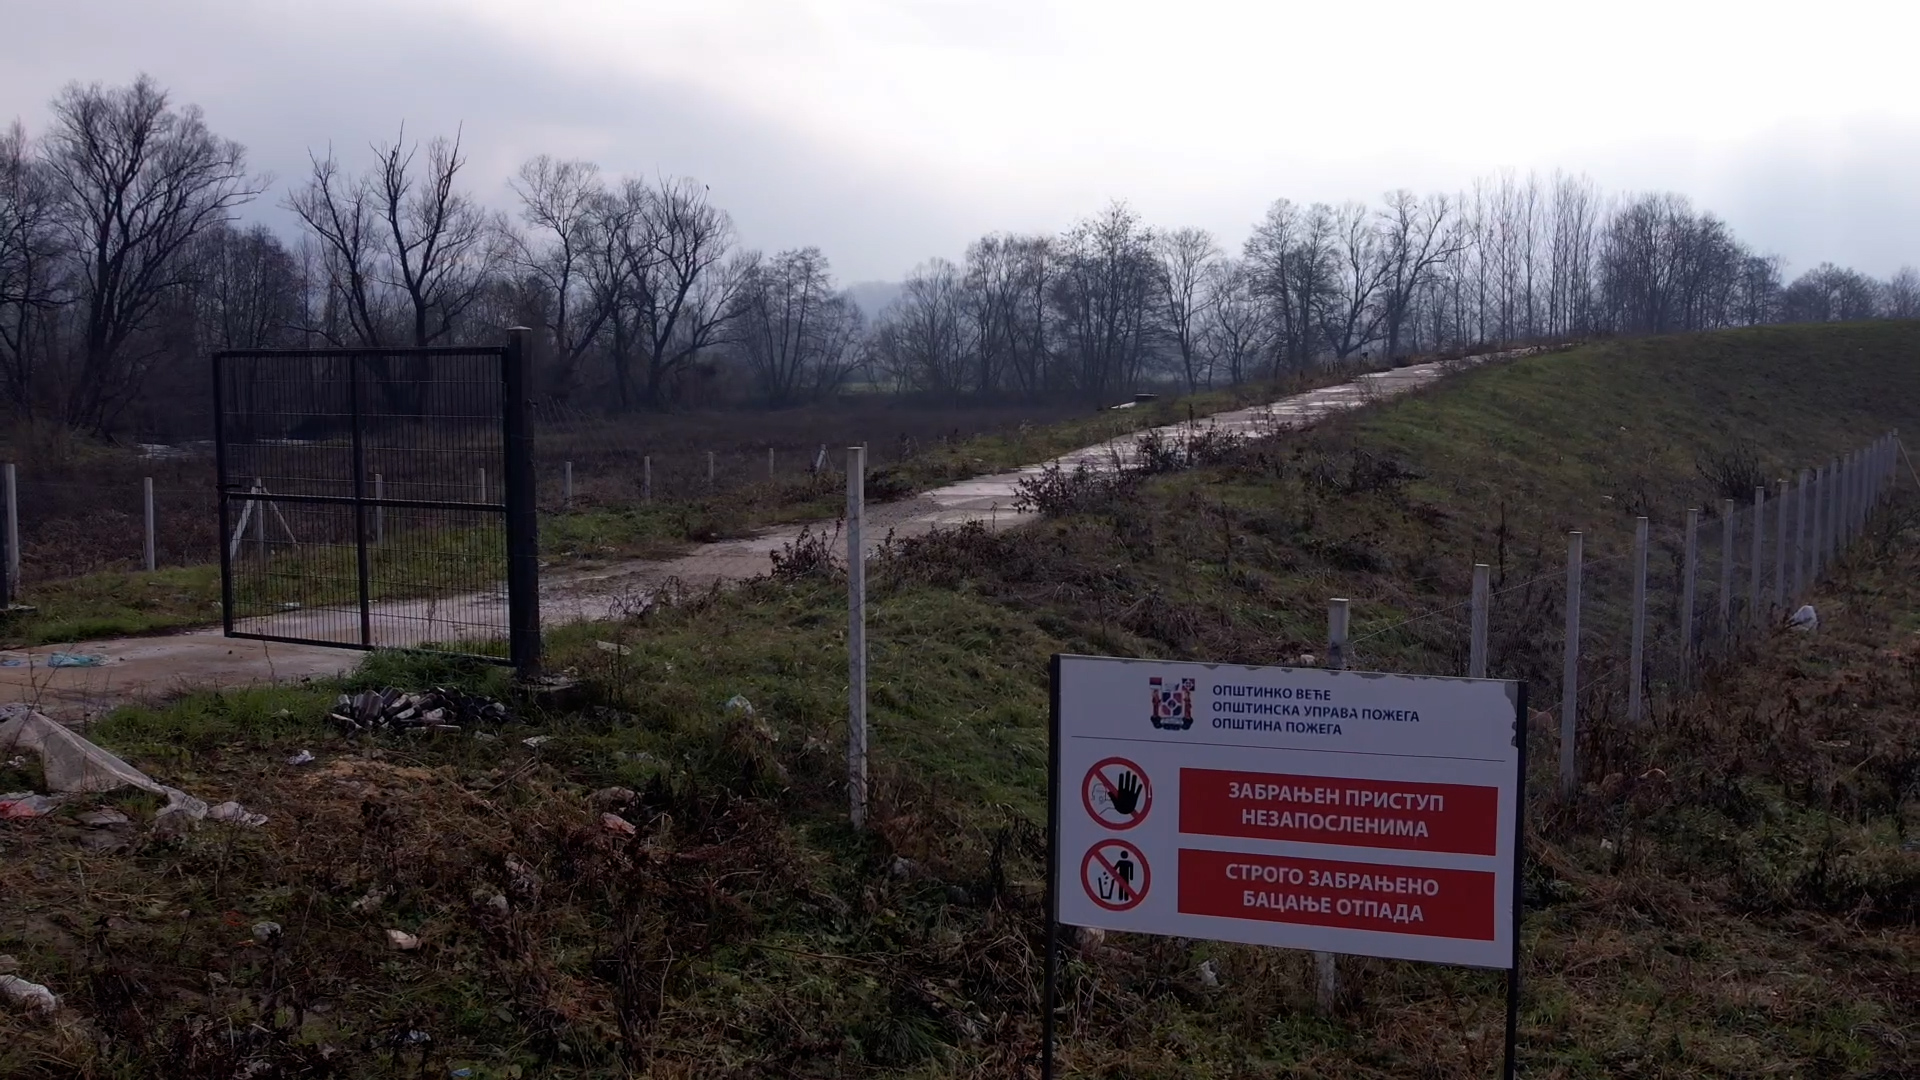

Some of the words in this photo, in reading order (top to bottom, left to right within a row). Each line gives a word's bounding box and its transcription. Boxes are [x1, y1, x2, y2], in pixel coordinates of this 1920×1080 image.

[1212, 685, 1292, 699] ОПШТИНКО
[1296, 689, 1331, 701] ВЕЋЕ
[1212, 701, 1300, 717] ОПШТИНСКА
[1304, 706, 1358, 720] УПРАВА
[1362, 708, 1420, 722] ПОЖЕГА
[1212, 718, 1282, 732] ОПШТИНА
[1286, 721, 1342, 735] ПОЖЕГА
[1228, 782, 1340, 805] ЗАБРАЊЕН
[1345, 789, 1444, 812] ПРИСТУП
[1242, 808, 1429, 838] НЕЗАПОСЛЕНИМА
[1225, 863, 1304, 885] СТРОГО
[1308, 869, 1439, 896] ЗАБРАЊЕНО
[1243, 890, 1331, 913] БАЦАЊЕ
[1336, 899, 1424, 923] ОТПАДА
